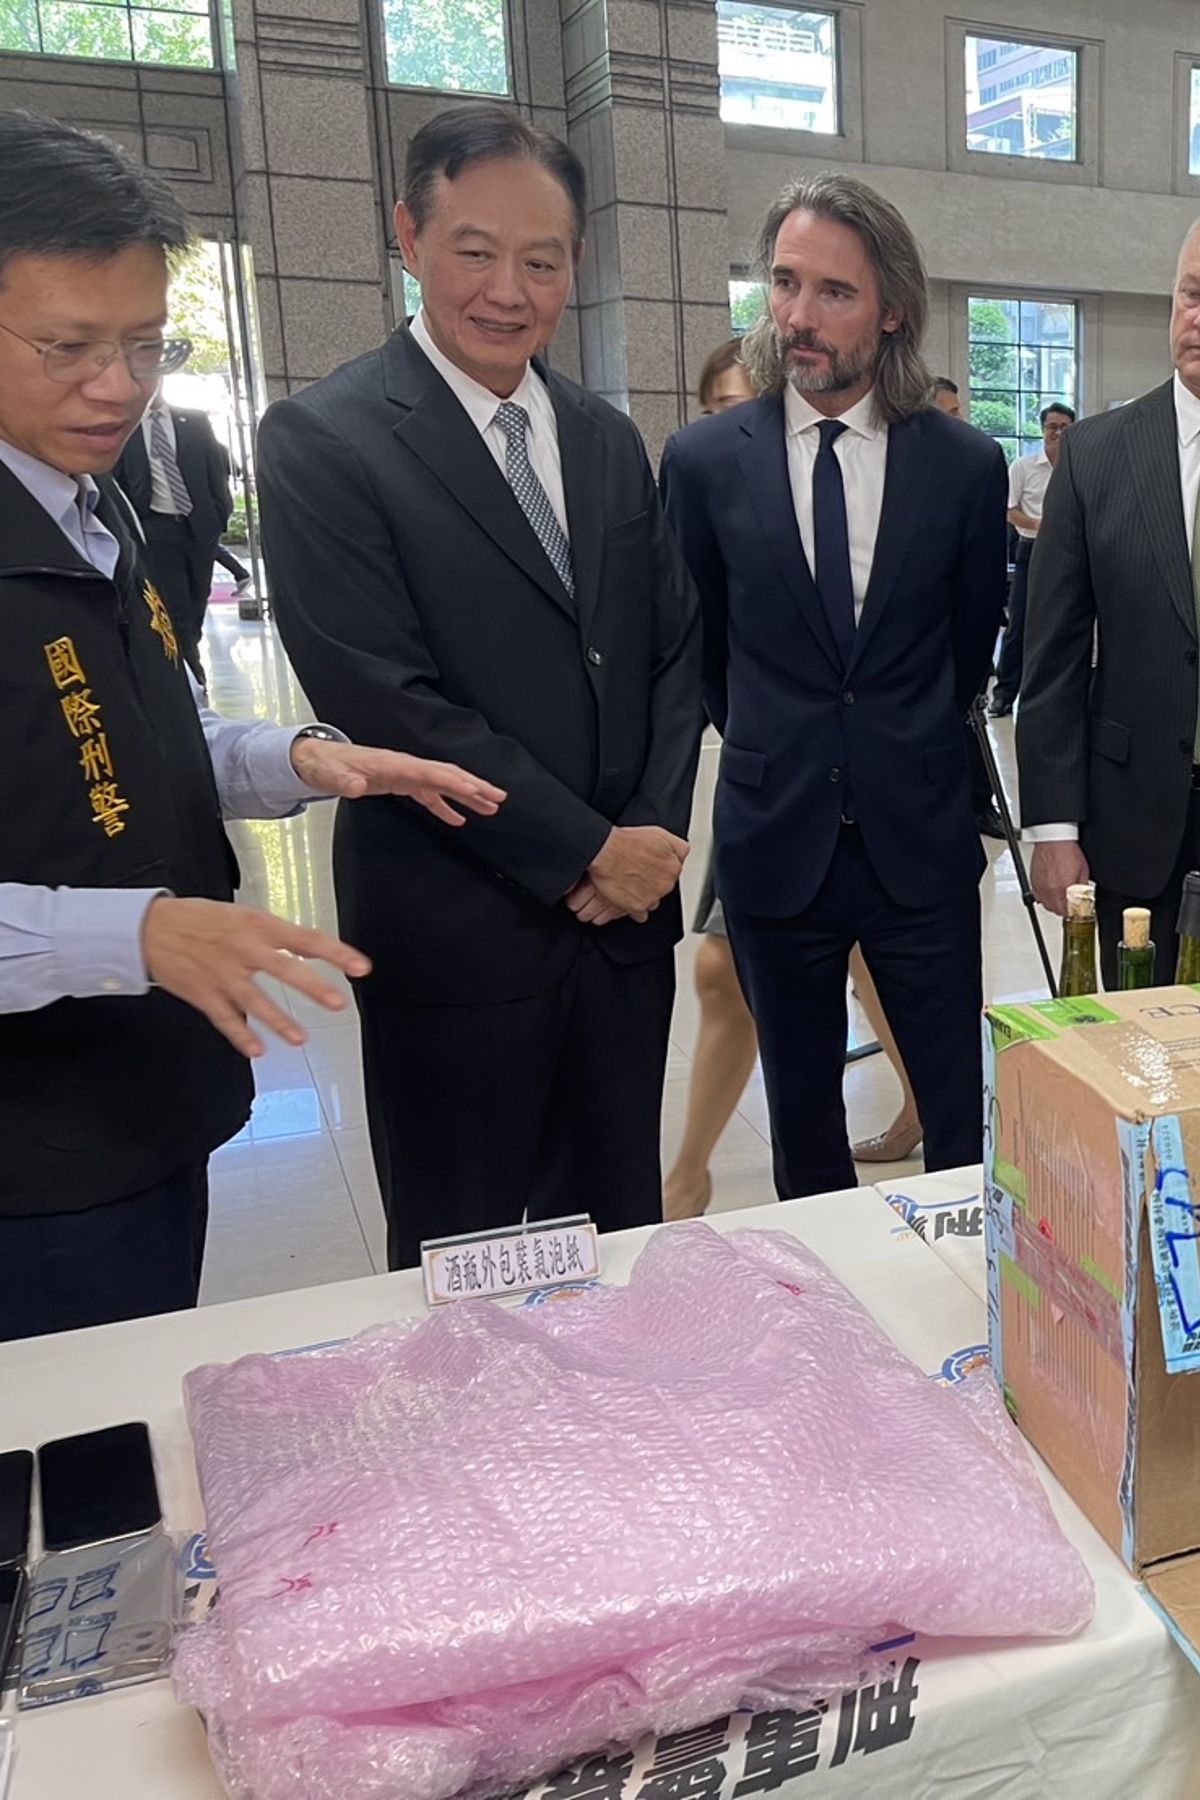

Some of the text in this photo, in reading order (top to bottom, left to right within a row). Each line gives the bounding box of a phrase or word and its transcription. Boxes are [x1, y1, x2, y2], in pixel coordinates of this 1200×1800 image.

[44, 636, 130, 838] 國際刑警
[445, 1234, 585, 1293] 酒瓶外包裝氣泡紙
